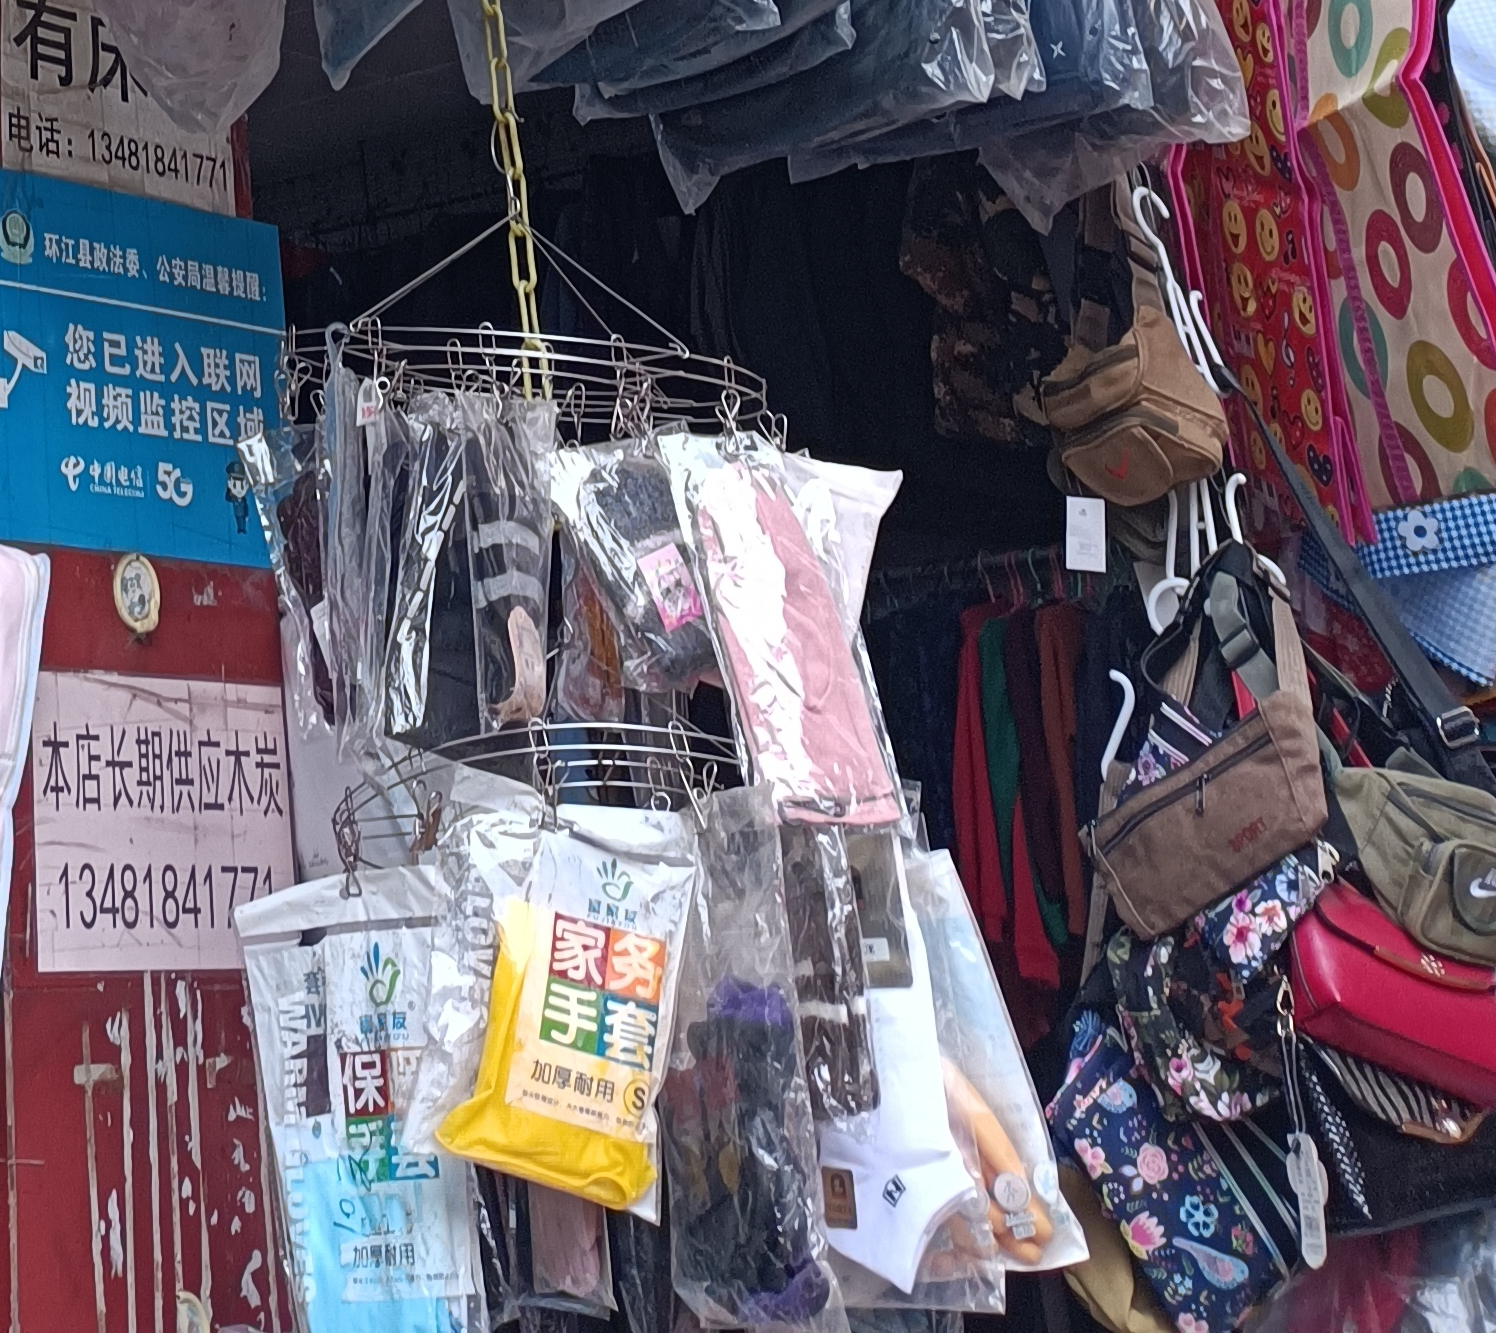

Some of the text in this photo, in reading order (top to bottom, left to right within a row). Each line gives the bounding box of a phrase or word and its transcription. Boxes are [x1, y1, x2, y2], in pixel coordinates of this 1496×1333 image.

[64, 322, 262, 399] 您已进入联网
[66, 378, 264, 446] 视频监控区域
[155, 461, 194, 507] 5G
[41, 720, 284, 818] 本店长期供应木炭
[551, 917, 663, 1000] 家务
[543, 982, 657, 1071] 手套
[530, 1058, 615, 1104] 加厚耐用
[631, 1086, 647, 1111] S
